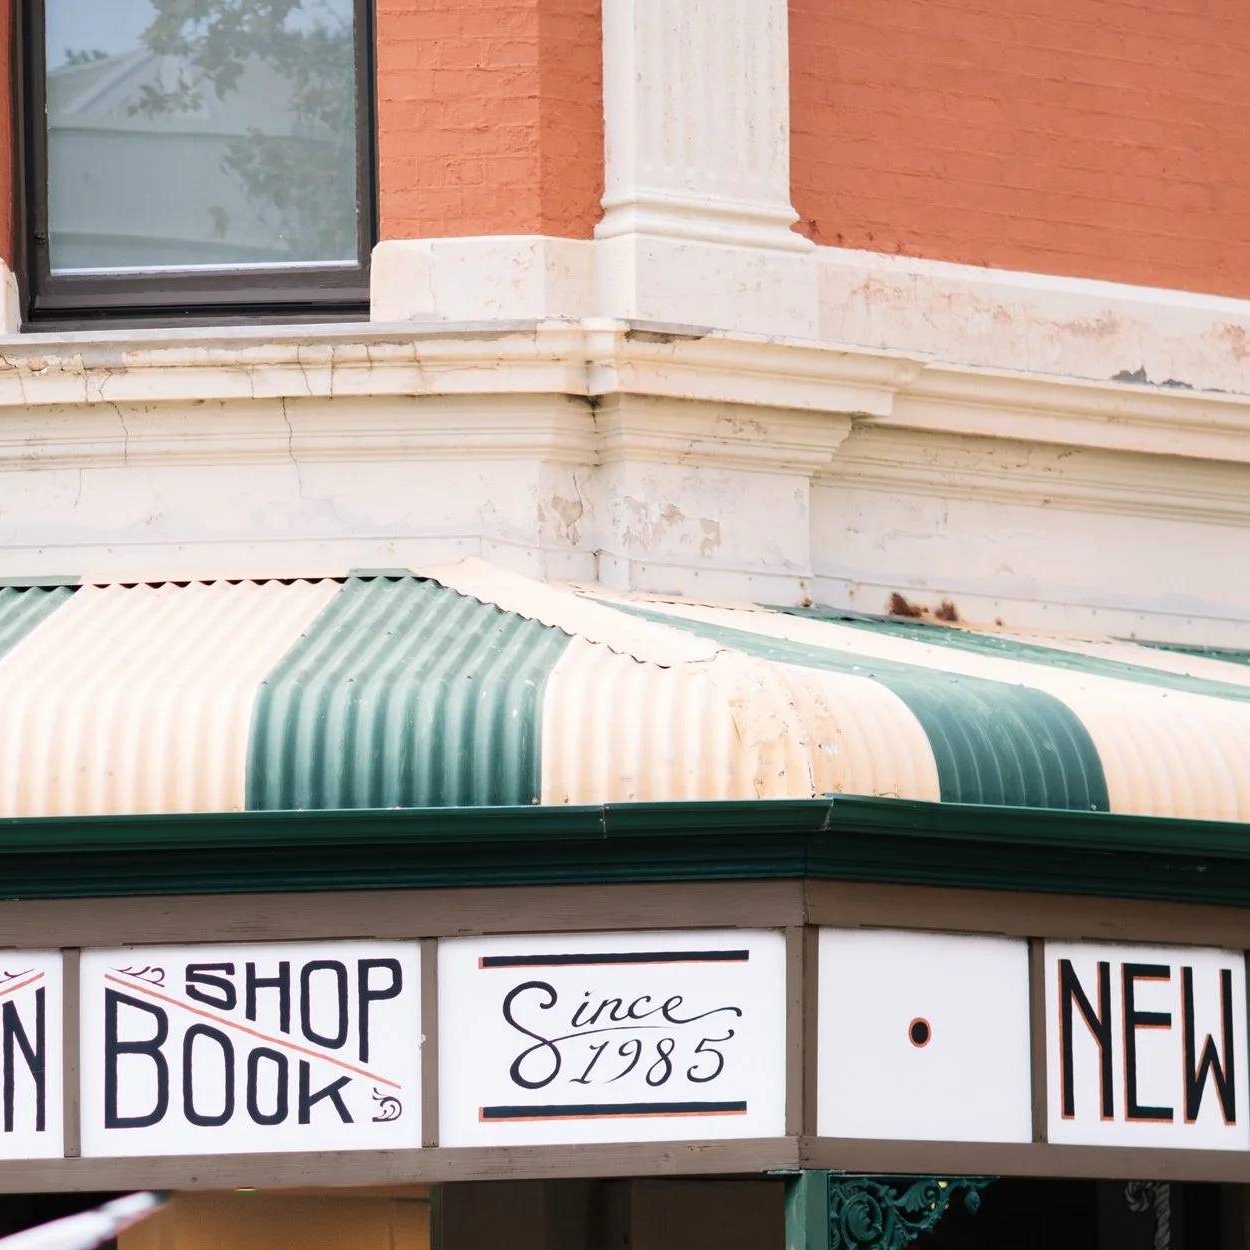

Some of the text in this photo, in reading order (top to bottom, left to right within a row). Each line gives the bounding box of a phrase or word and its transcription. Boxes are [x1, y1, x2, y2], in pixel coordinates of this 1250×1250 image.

[104, 987, 355, 1130] BOOK
[185, 957, 403, 1063] SHOP
[502, 980, 743, 1090] Since
[569, 1028, 735, 1085] 1985
[1057, 958, 1237, 1127] NEW
